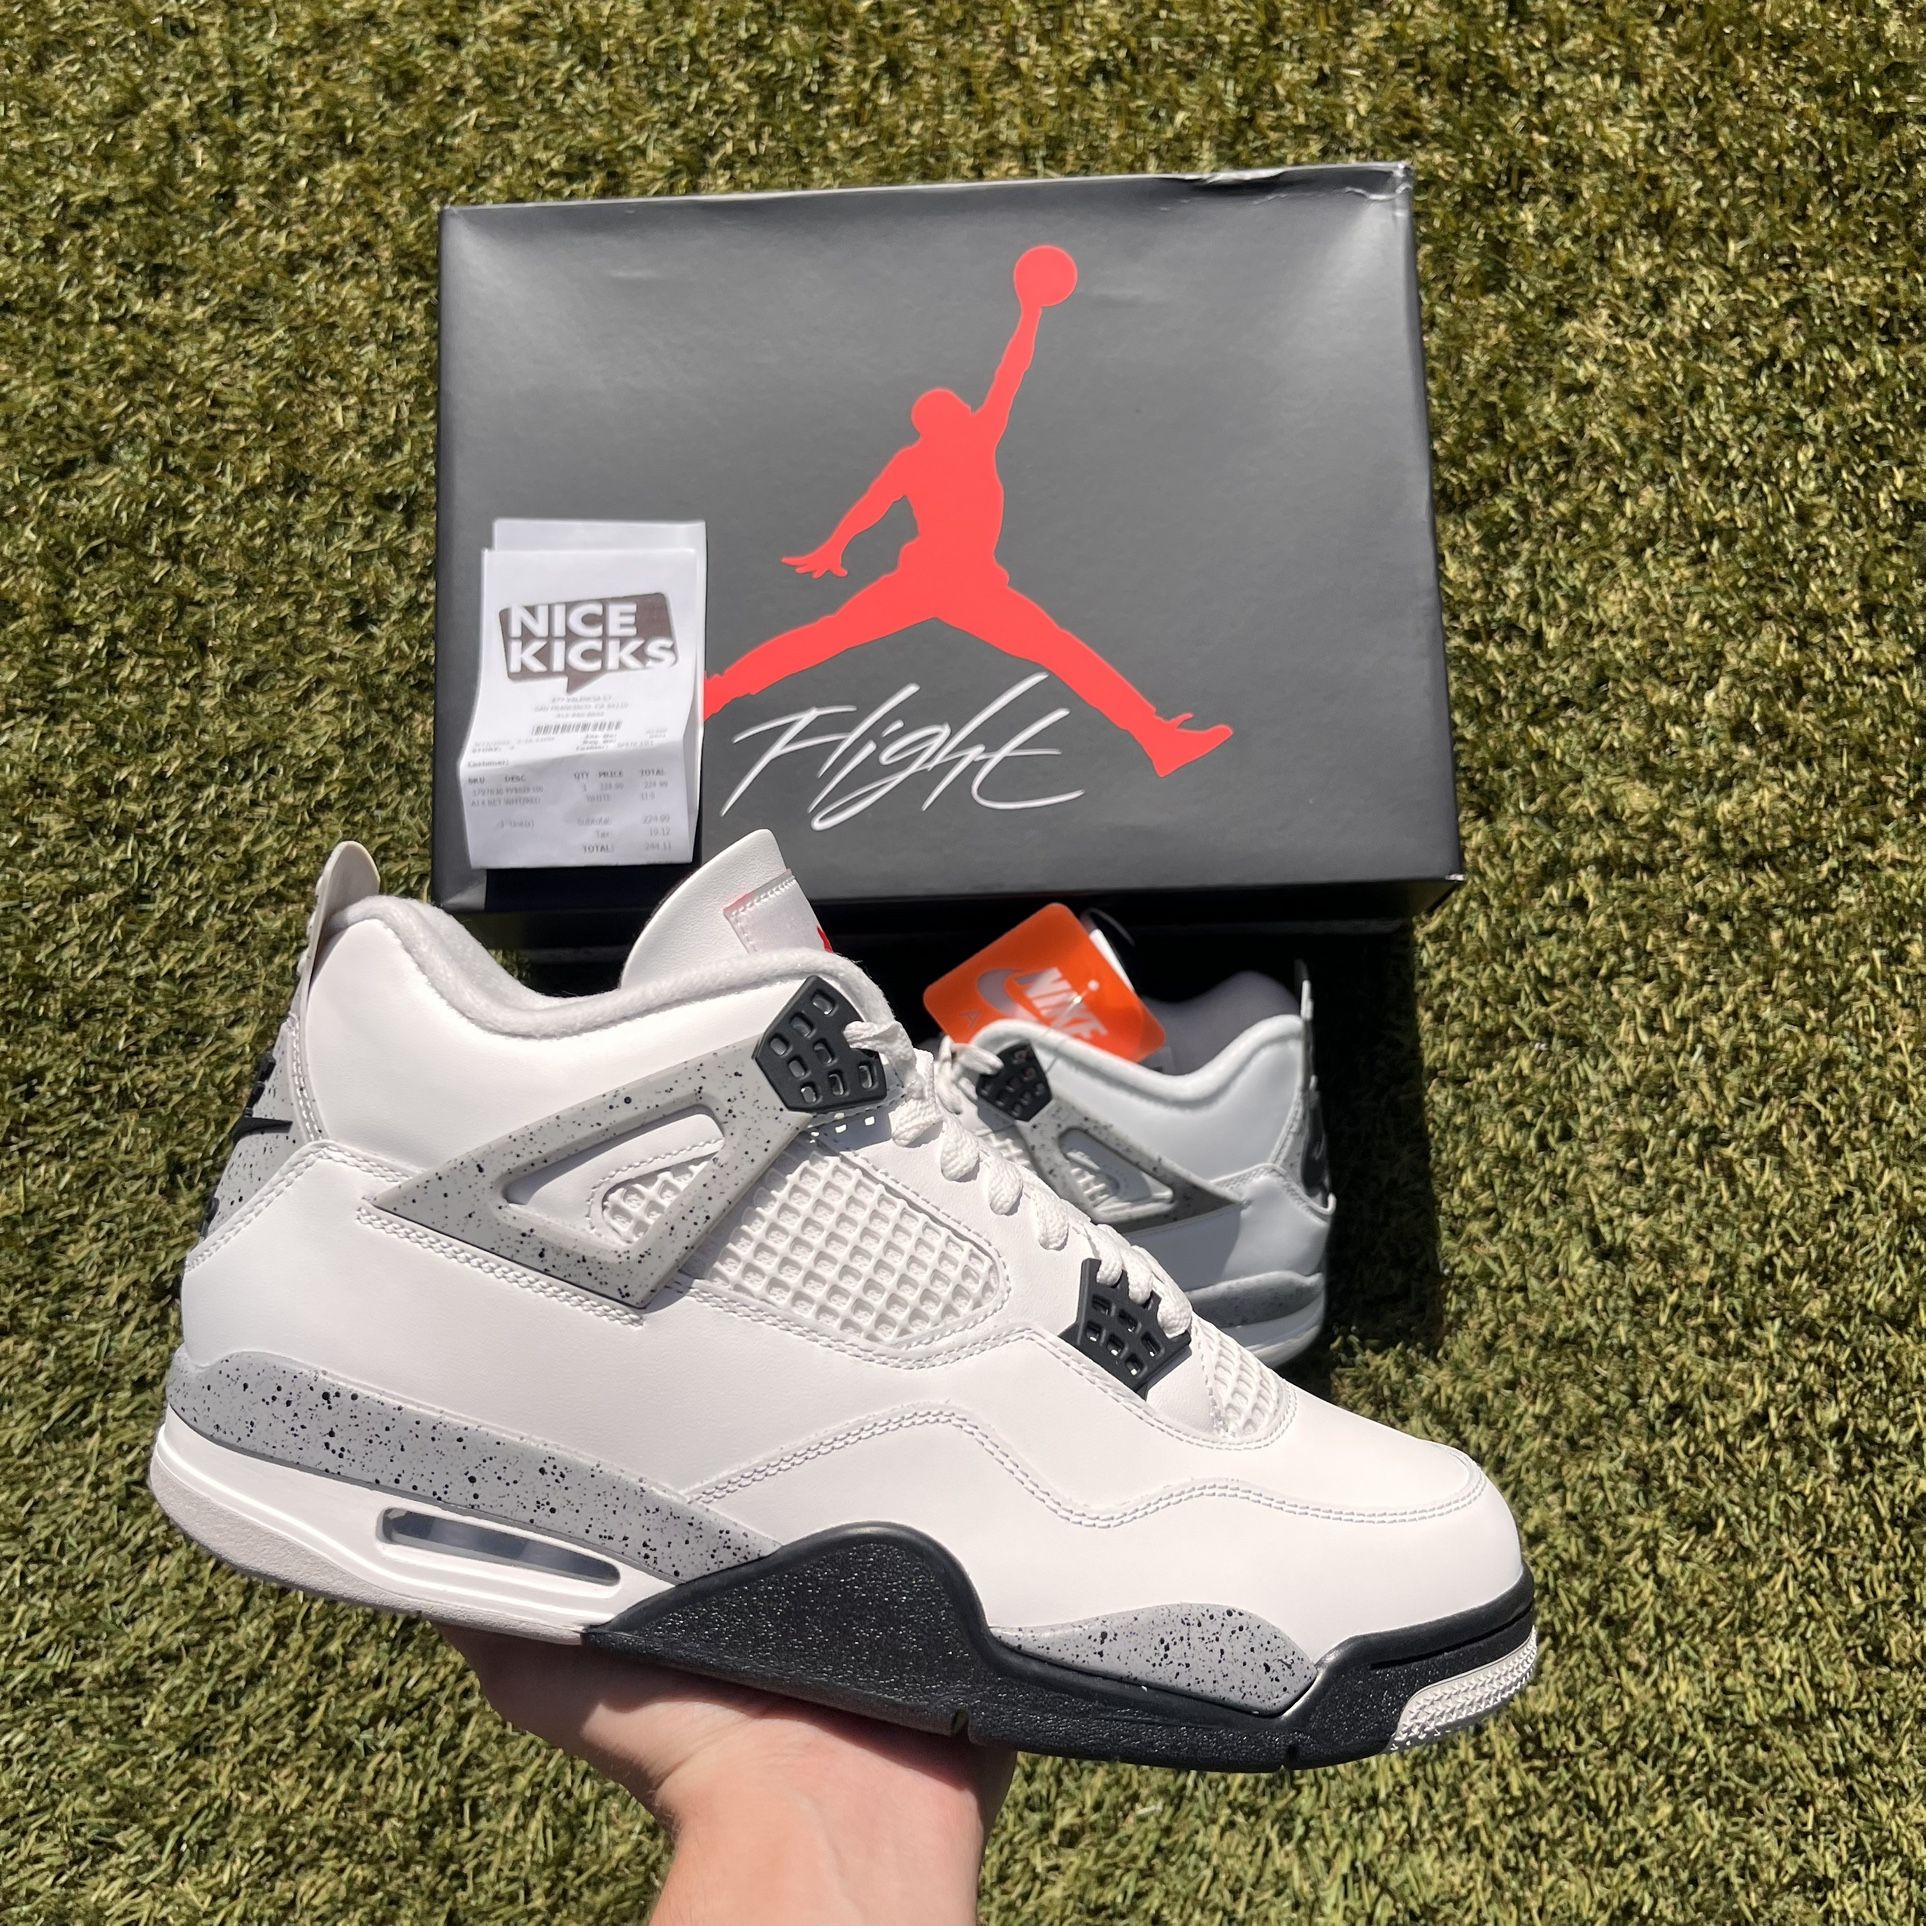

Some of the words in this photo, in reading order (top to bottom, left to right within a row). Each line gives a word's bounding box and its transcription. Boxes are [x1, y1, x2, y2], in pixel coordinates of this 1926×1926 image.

[508, 602, 638, 638] NICE
[508, 638, 677, 674] KICKS
[720, 671, 1085, 831] Flight
[504, 774, 527, 782] DESC
[574, 771, 590, 780] QTY
[598, 770, 624, 778] PRICE
[640, 768, 665, 777] TOTAL
[1017, 966, 1109, 1040] NIKE
